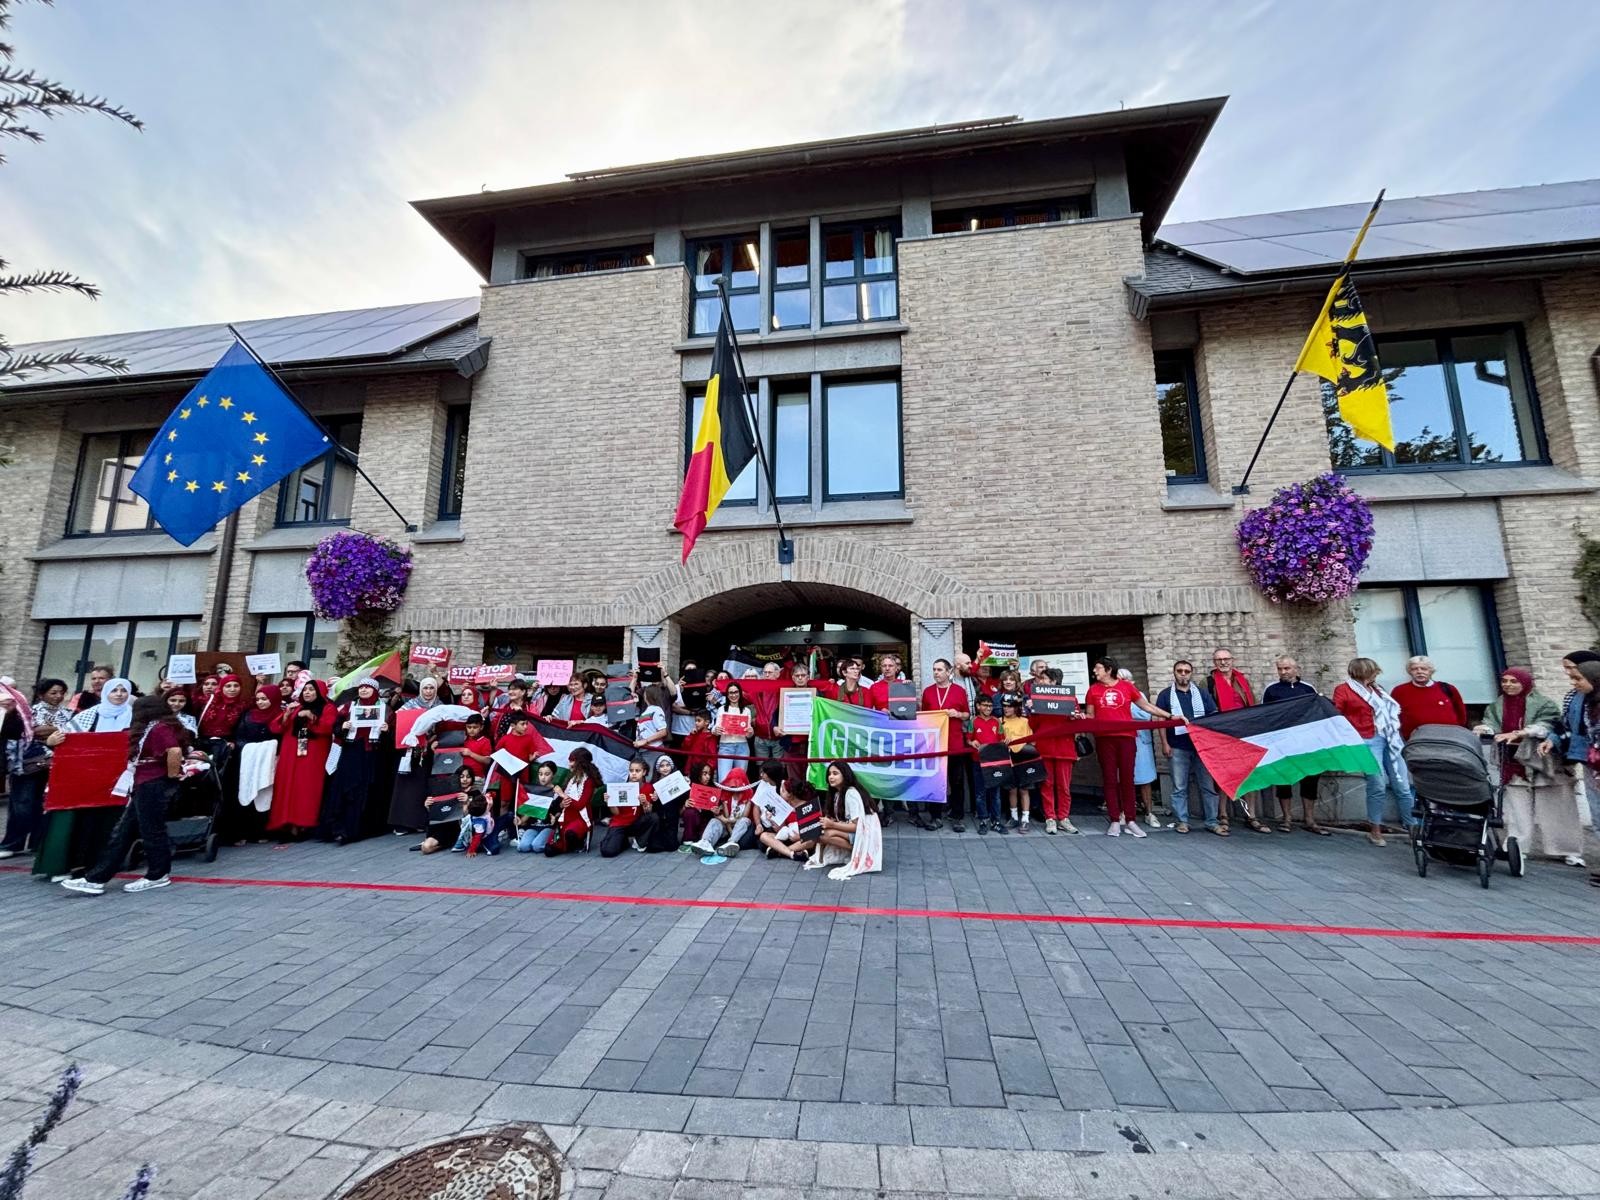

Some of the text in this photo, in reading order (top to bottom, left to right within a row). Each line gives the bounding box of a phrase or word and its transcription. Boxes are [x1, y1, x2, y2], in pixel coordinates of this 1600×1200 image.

[414, 646, 444, 656] STOP
[479, 665, 507, 675] STOP
[1035, 686, 1071, 695] SANCTIES
[821, 721, 937, 771] GROEN
